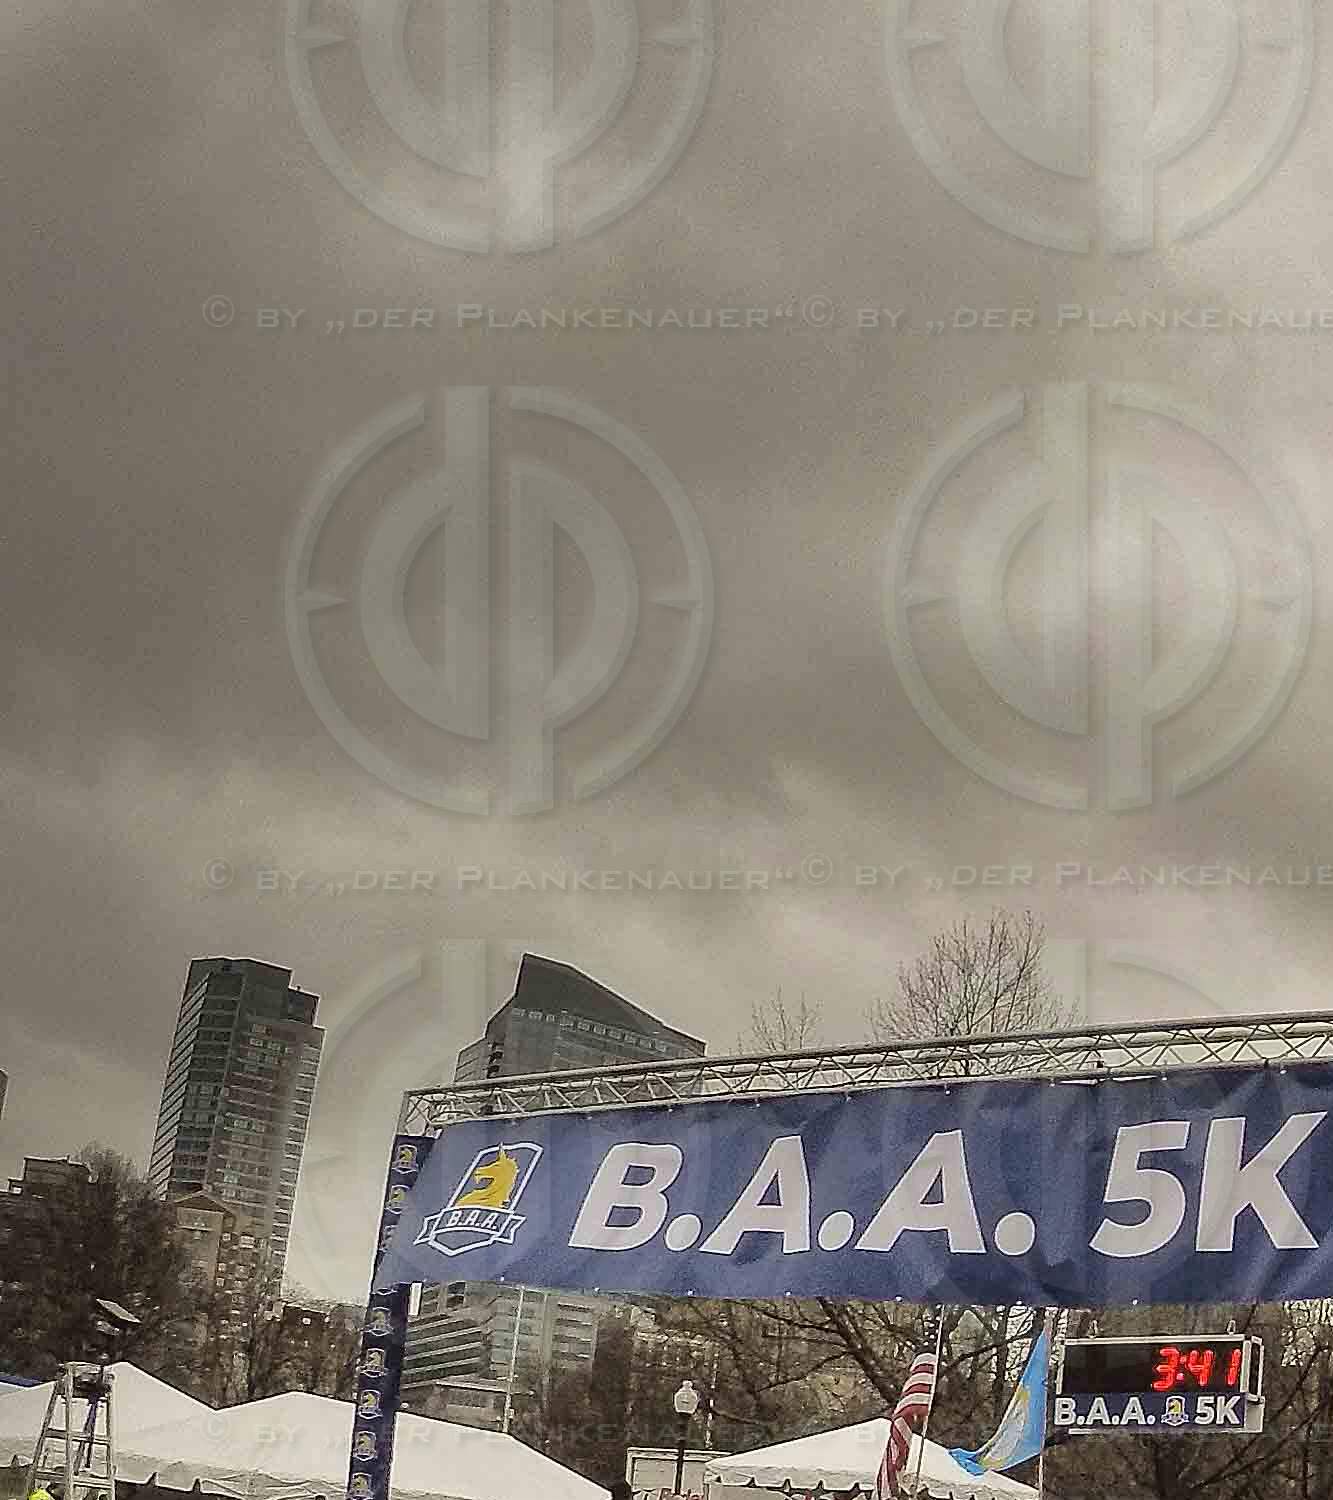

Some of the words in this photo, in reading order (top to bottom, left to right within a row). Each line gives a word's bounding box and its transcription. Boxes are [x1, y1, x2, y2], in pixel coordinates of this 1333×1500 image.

[568, 1130, 1036, 1255] B.A.A.
[1089, 1110, 1328, 1258] 5K
[447, 1210, 498, 1230] B.A.A.
[1151, 1346, 1242, 1391] 3:41
[1054, 1396, 1156, 1426] B.A.A.
[1194, 1396, 1241, 1425] 5K
